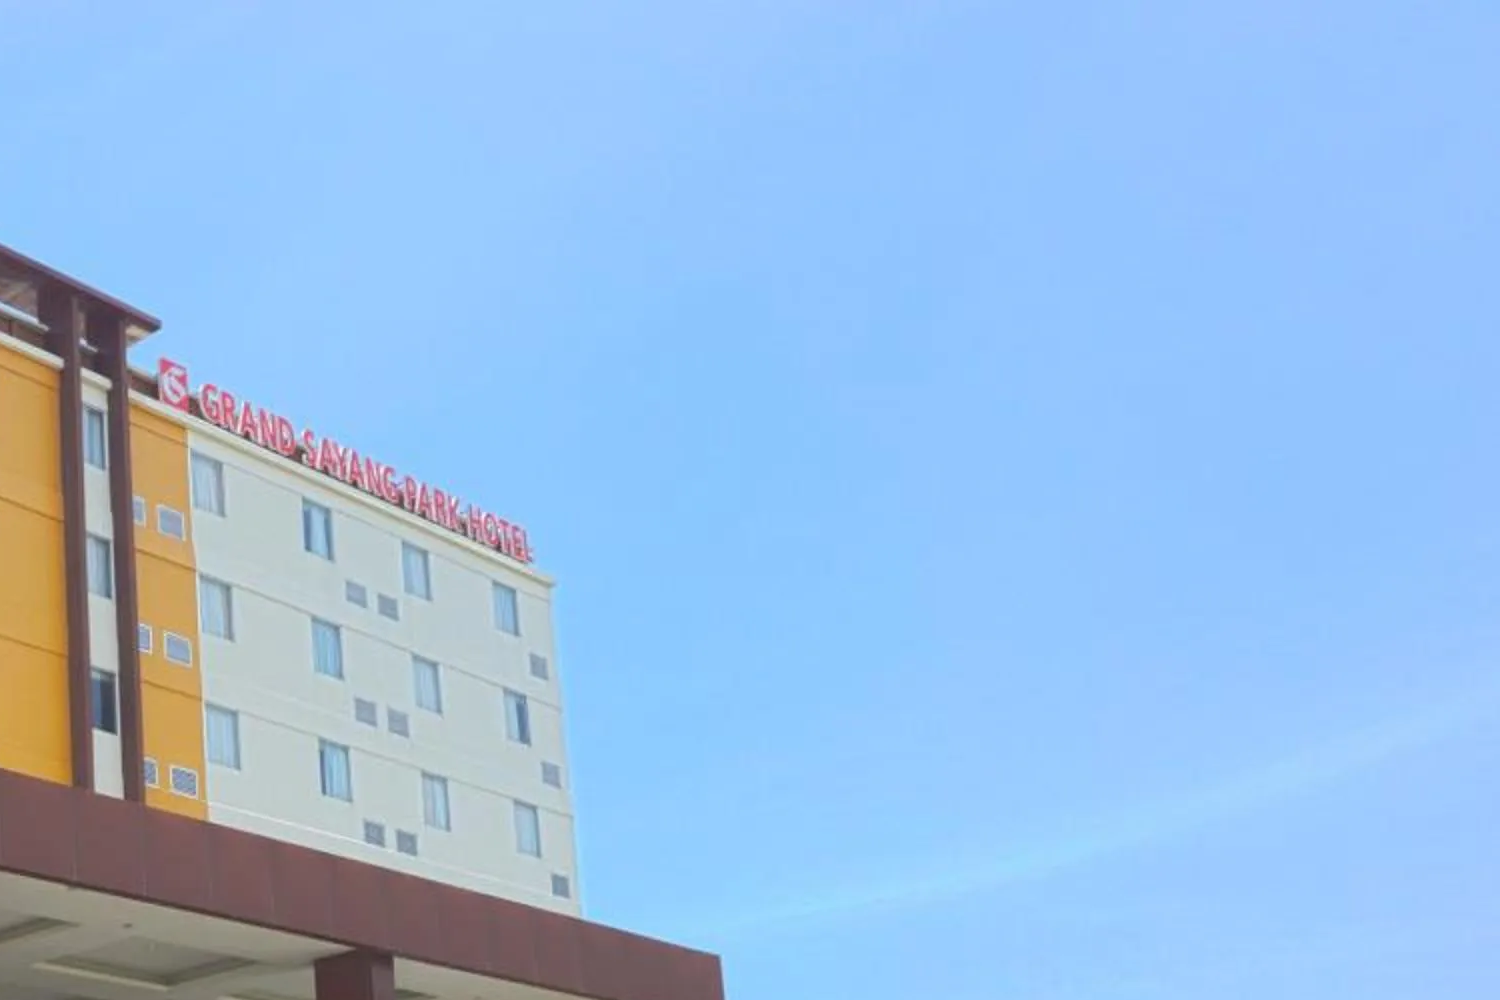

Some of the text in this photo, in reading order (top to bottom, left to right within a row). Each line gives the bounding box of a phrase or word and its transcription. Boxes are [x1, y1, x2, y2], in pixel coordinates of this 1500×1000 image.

[199, 383, 296, 456] GRAND
[301, 430, 398, 504] SAYANG
[403, 475, 461, 532] PARK
[466, 503, 532, 562] HOTEL
